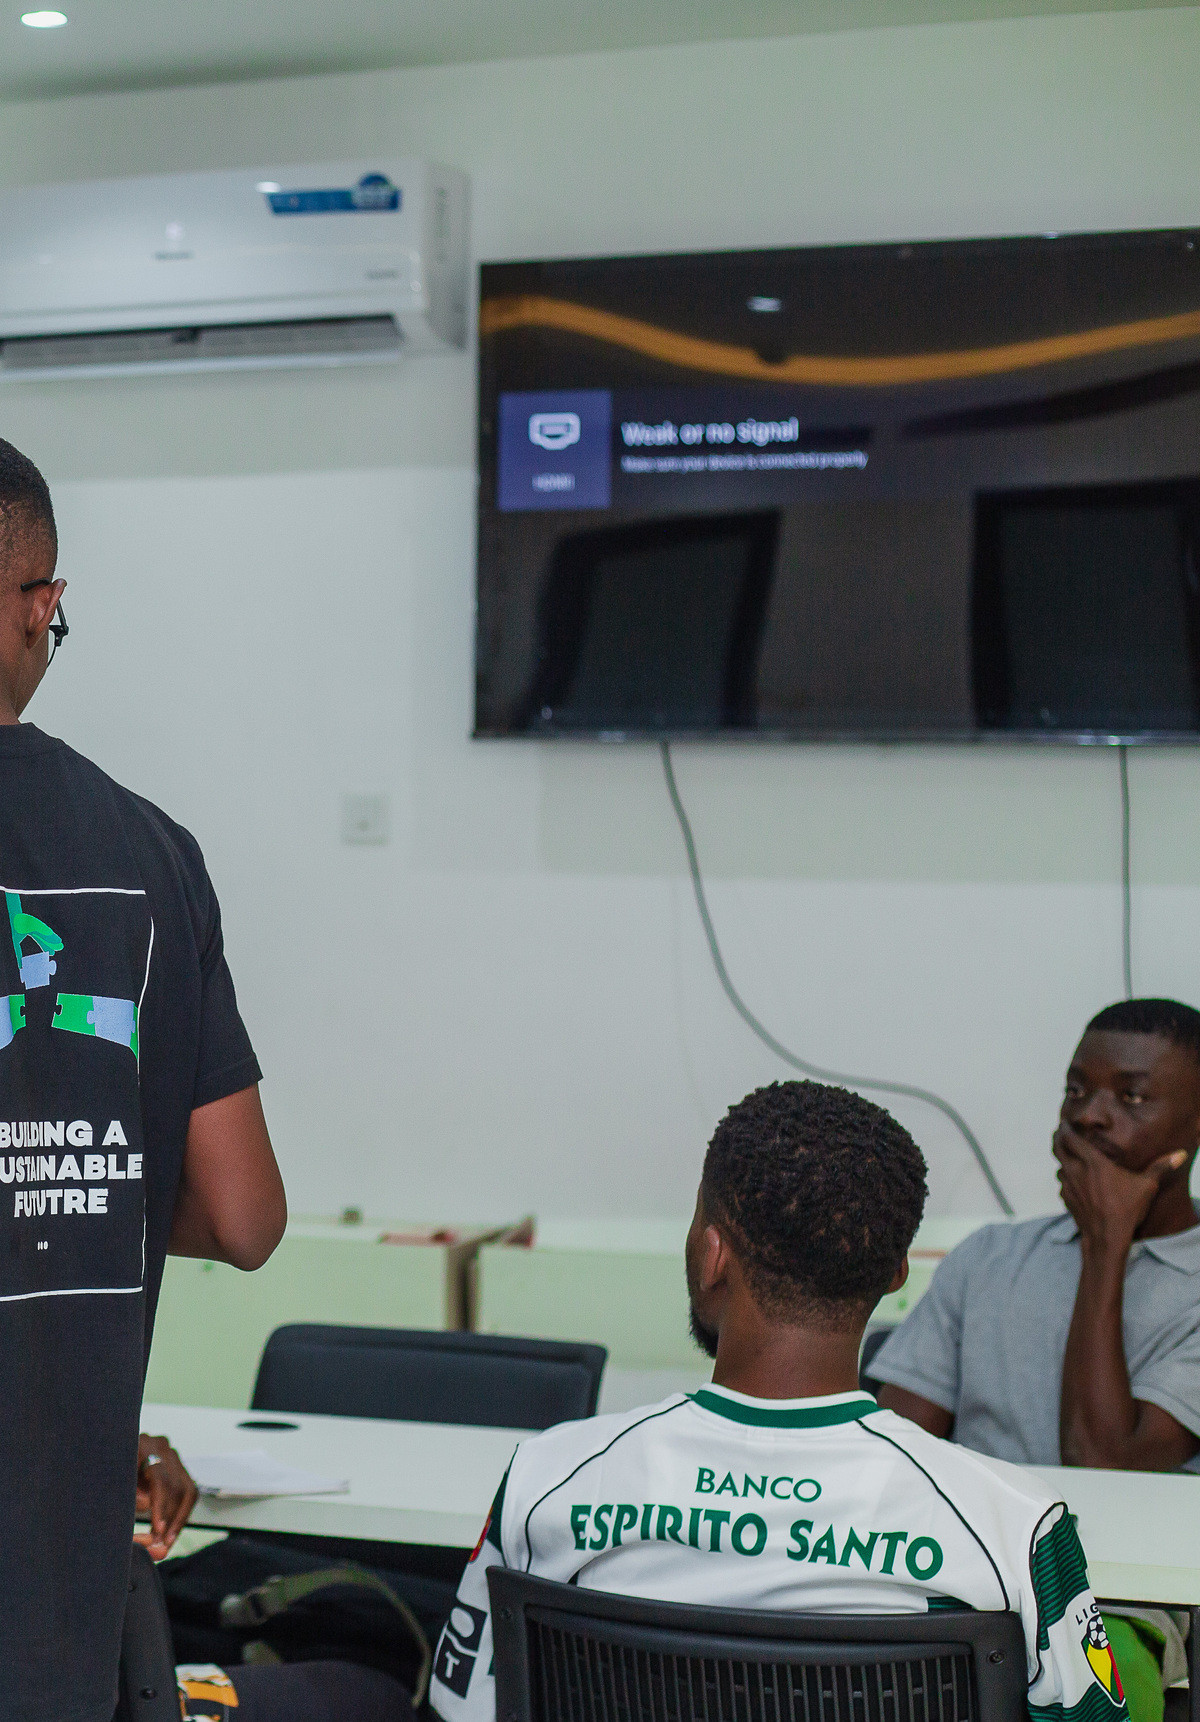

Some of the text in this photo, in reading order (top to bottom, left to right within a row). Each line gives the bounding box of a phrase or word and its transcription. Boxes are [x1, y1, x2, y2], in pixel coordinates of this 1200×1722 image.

[621, 416, 799, 447] Weak or no signal
[102, 1120, 128, 1146] A
[695, 1467, 822, 1503] BANCO
[570, 1504, 768, 1557] ESPIRITO
[786, 1519, 943, 1581] SANTO
